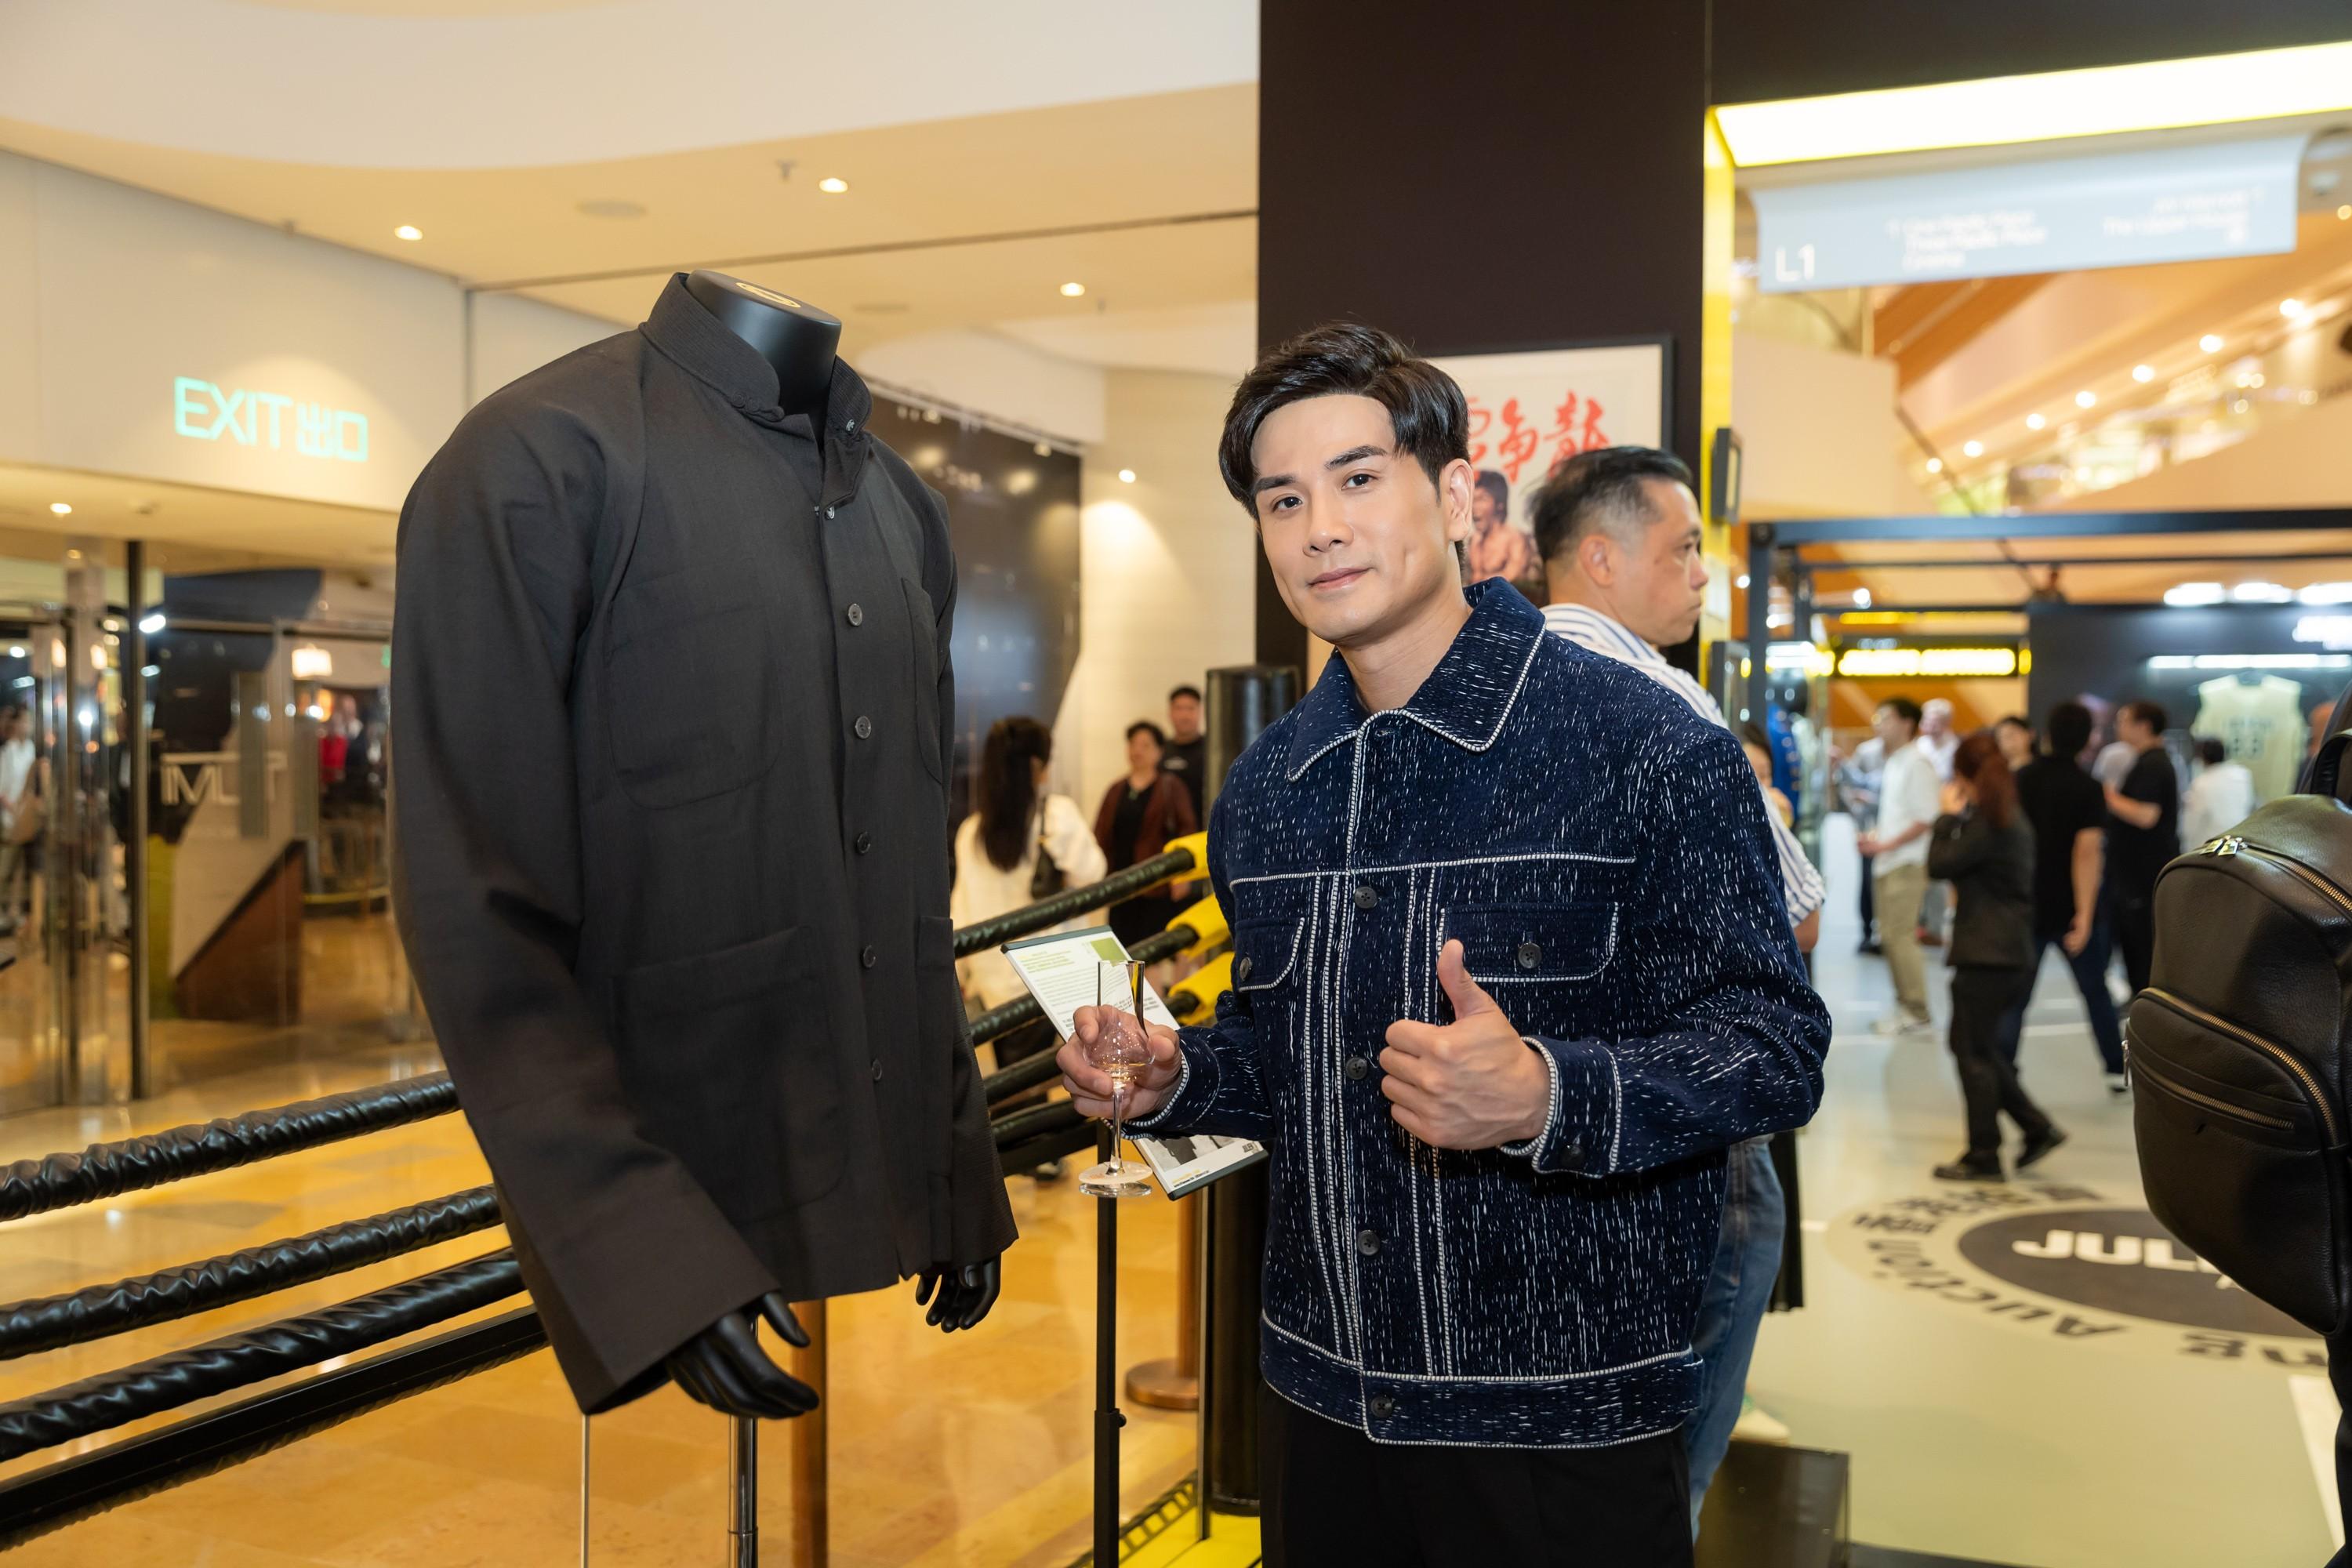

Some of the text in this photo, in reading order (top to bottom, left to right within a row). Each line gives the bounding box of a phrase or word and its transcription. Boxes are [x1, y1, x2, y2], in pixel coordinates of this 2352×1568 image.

[1775, 244, 1815, 282] L1
[174, 376, 368, 462] EXIT 出口
[2012, 1229, 2222, 1273] JUL
